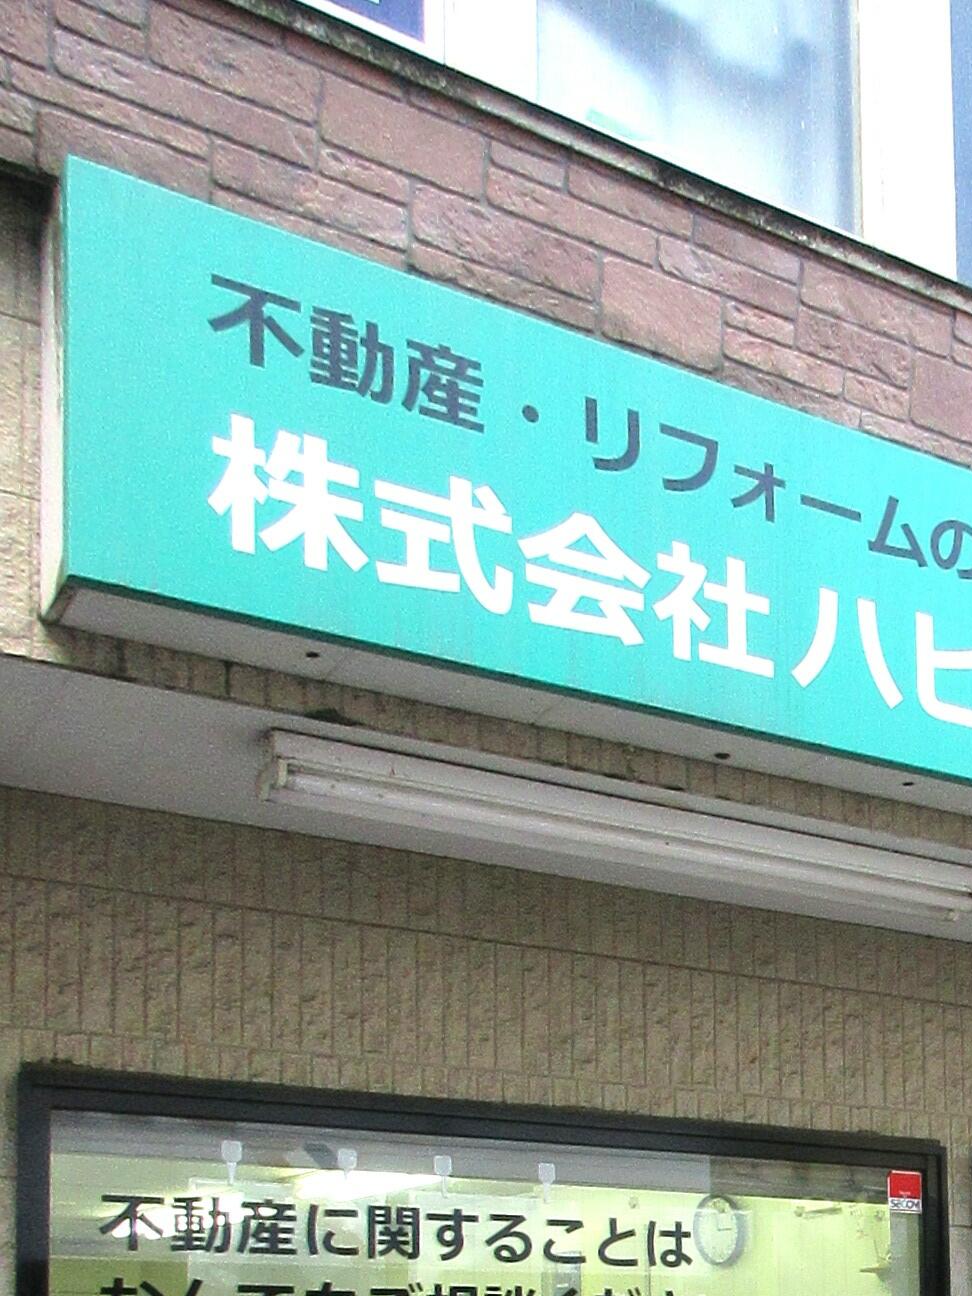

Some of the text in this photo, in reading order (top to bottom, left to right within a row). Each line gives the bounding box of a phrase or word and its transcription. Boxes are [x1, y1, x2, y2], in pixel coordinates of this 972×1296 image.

[99, 1193, 694, 1268] 不動産に関することは
